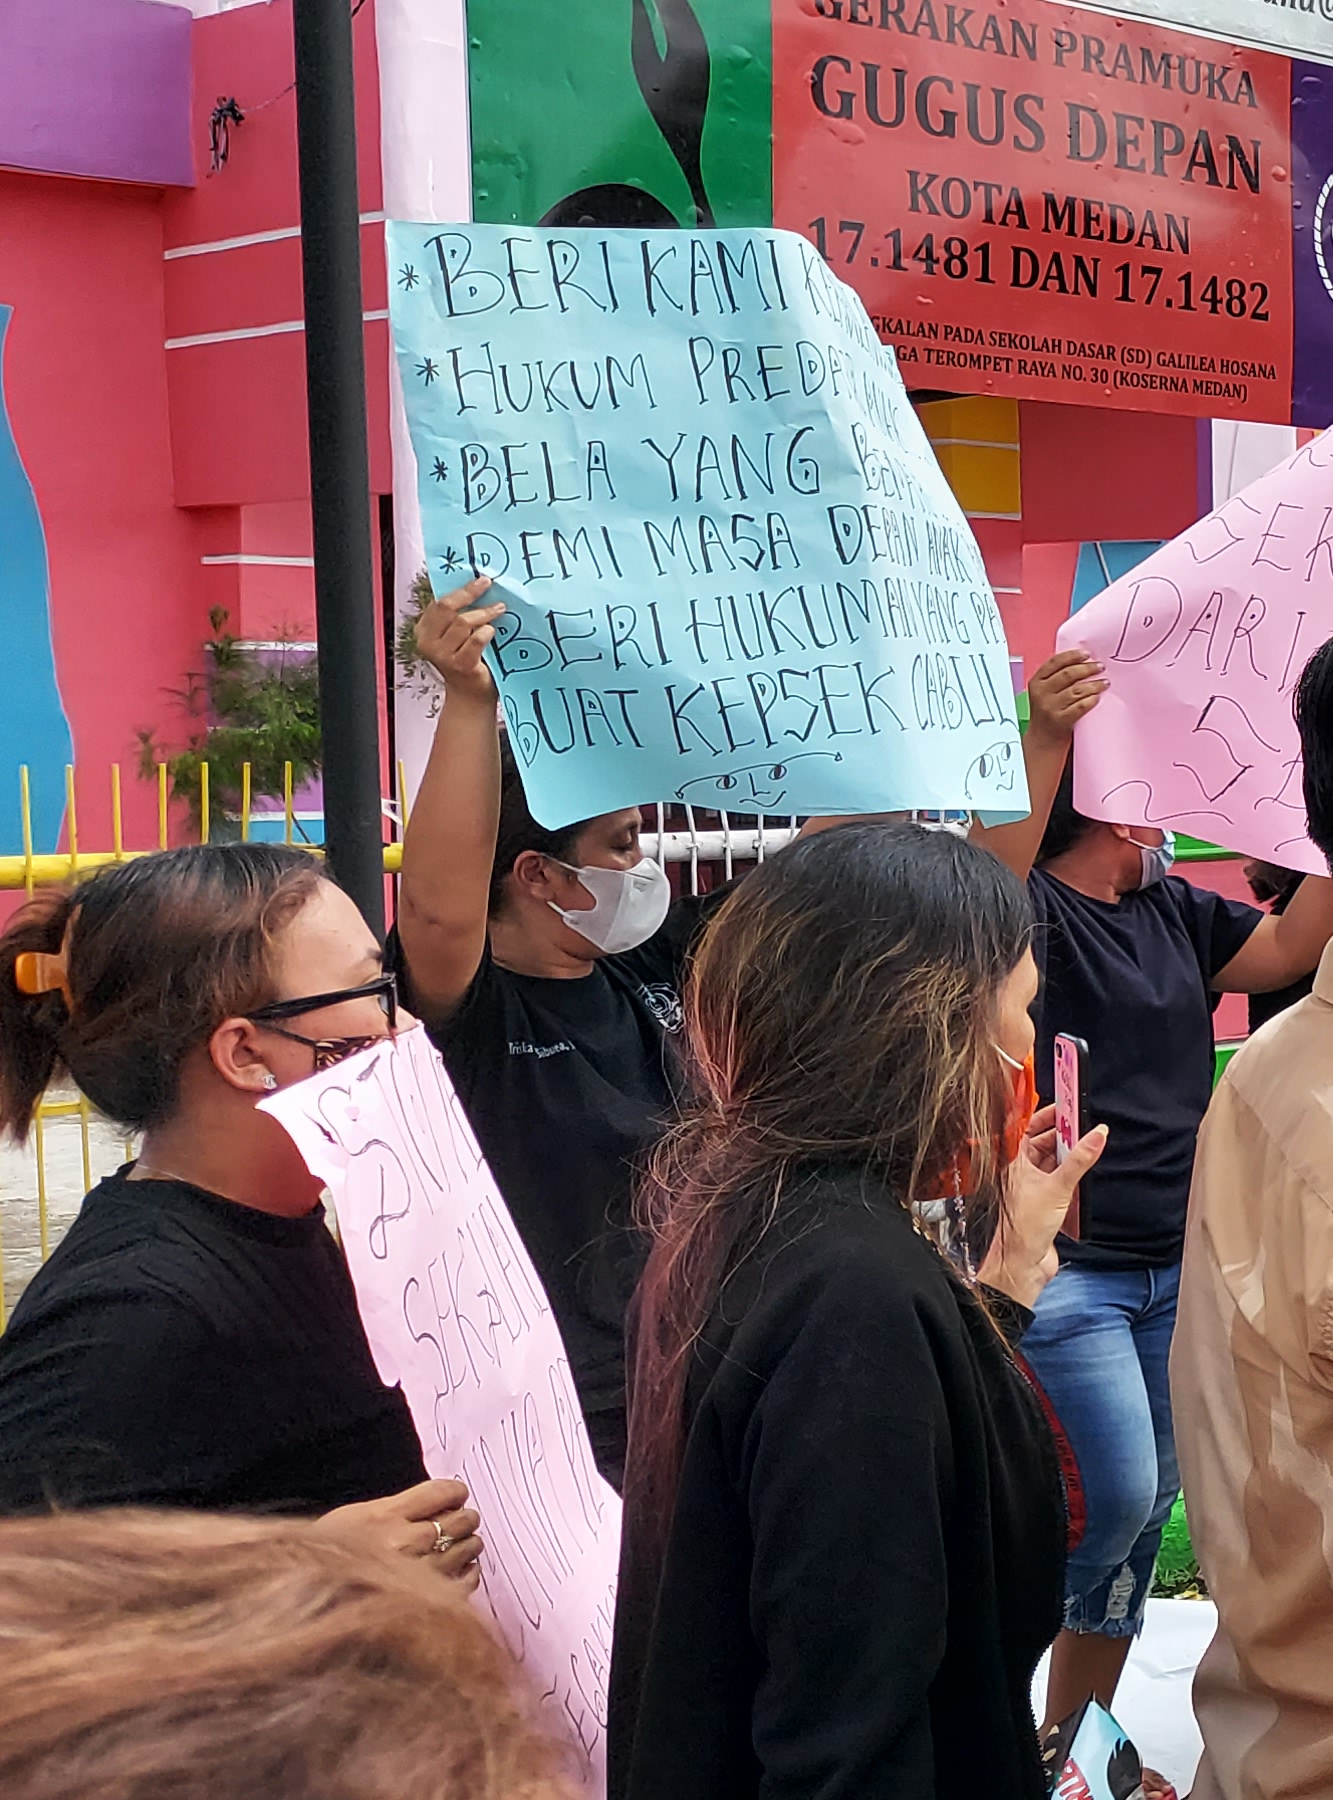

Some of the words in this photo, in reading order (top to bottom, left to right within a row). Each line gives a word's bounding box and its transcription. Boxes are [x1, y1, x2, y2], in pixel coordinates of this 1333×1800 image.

[1053, 27, 1259, 109] PRAMUKA
[811, 54, 1046, 155] GUGUS
[1066, 101, 1261, 195] DEPAN
[906, 169, 1029, 231] KOTA
[1041, 192, 1191, 255] MEDAN
[425, 231, 620, 317] BERI
[643, 236, 790, 317] KAMI
[808, 215, 997, 284] 17.1481
[1009, 246, 1101, 299] DAN
[1113, 261, 1271, 322] 17.1482
[447, 339, 658, 417] HUKUM
[871, 315, 939, 341] GKALAN
[943, 324, 985, 346] PADA
[989, 330, 1062, 355] SEKOLAH
[1066, 340, 1117, 361] DASAR
[1120, 345, 1152, 369] (SD)
[1156, 351, 1217, 374] GALILEA
[1219, 358, 1277, 380] HOSANA
[923, 348, 1013, 374] TEROMPET
[1018, 359, 1057, 379] RAYA
[1061, 364, 1087, 382] NO.
[1090, 367, 1109, 384] 30
[1113, 370, 1189, 393] (KOSERNA
[1192, 380, 1248, 403] MEDAN)
[459, 439, 616, 516] BELA
[641, 425, 821, 502] YANG
[466, 524, 625, 586] DEMI
[644, 513, 801, 578] MASA
[828, 503, 920, 567] DEPAN
[491, 600, 674, 682] BERI
[1109, 575, 1307, 694] DARI
[507, 687, 645, 768] BUAT
[665, 662, 909, 757] KEPSEK
